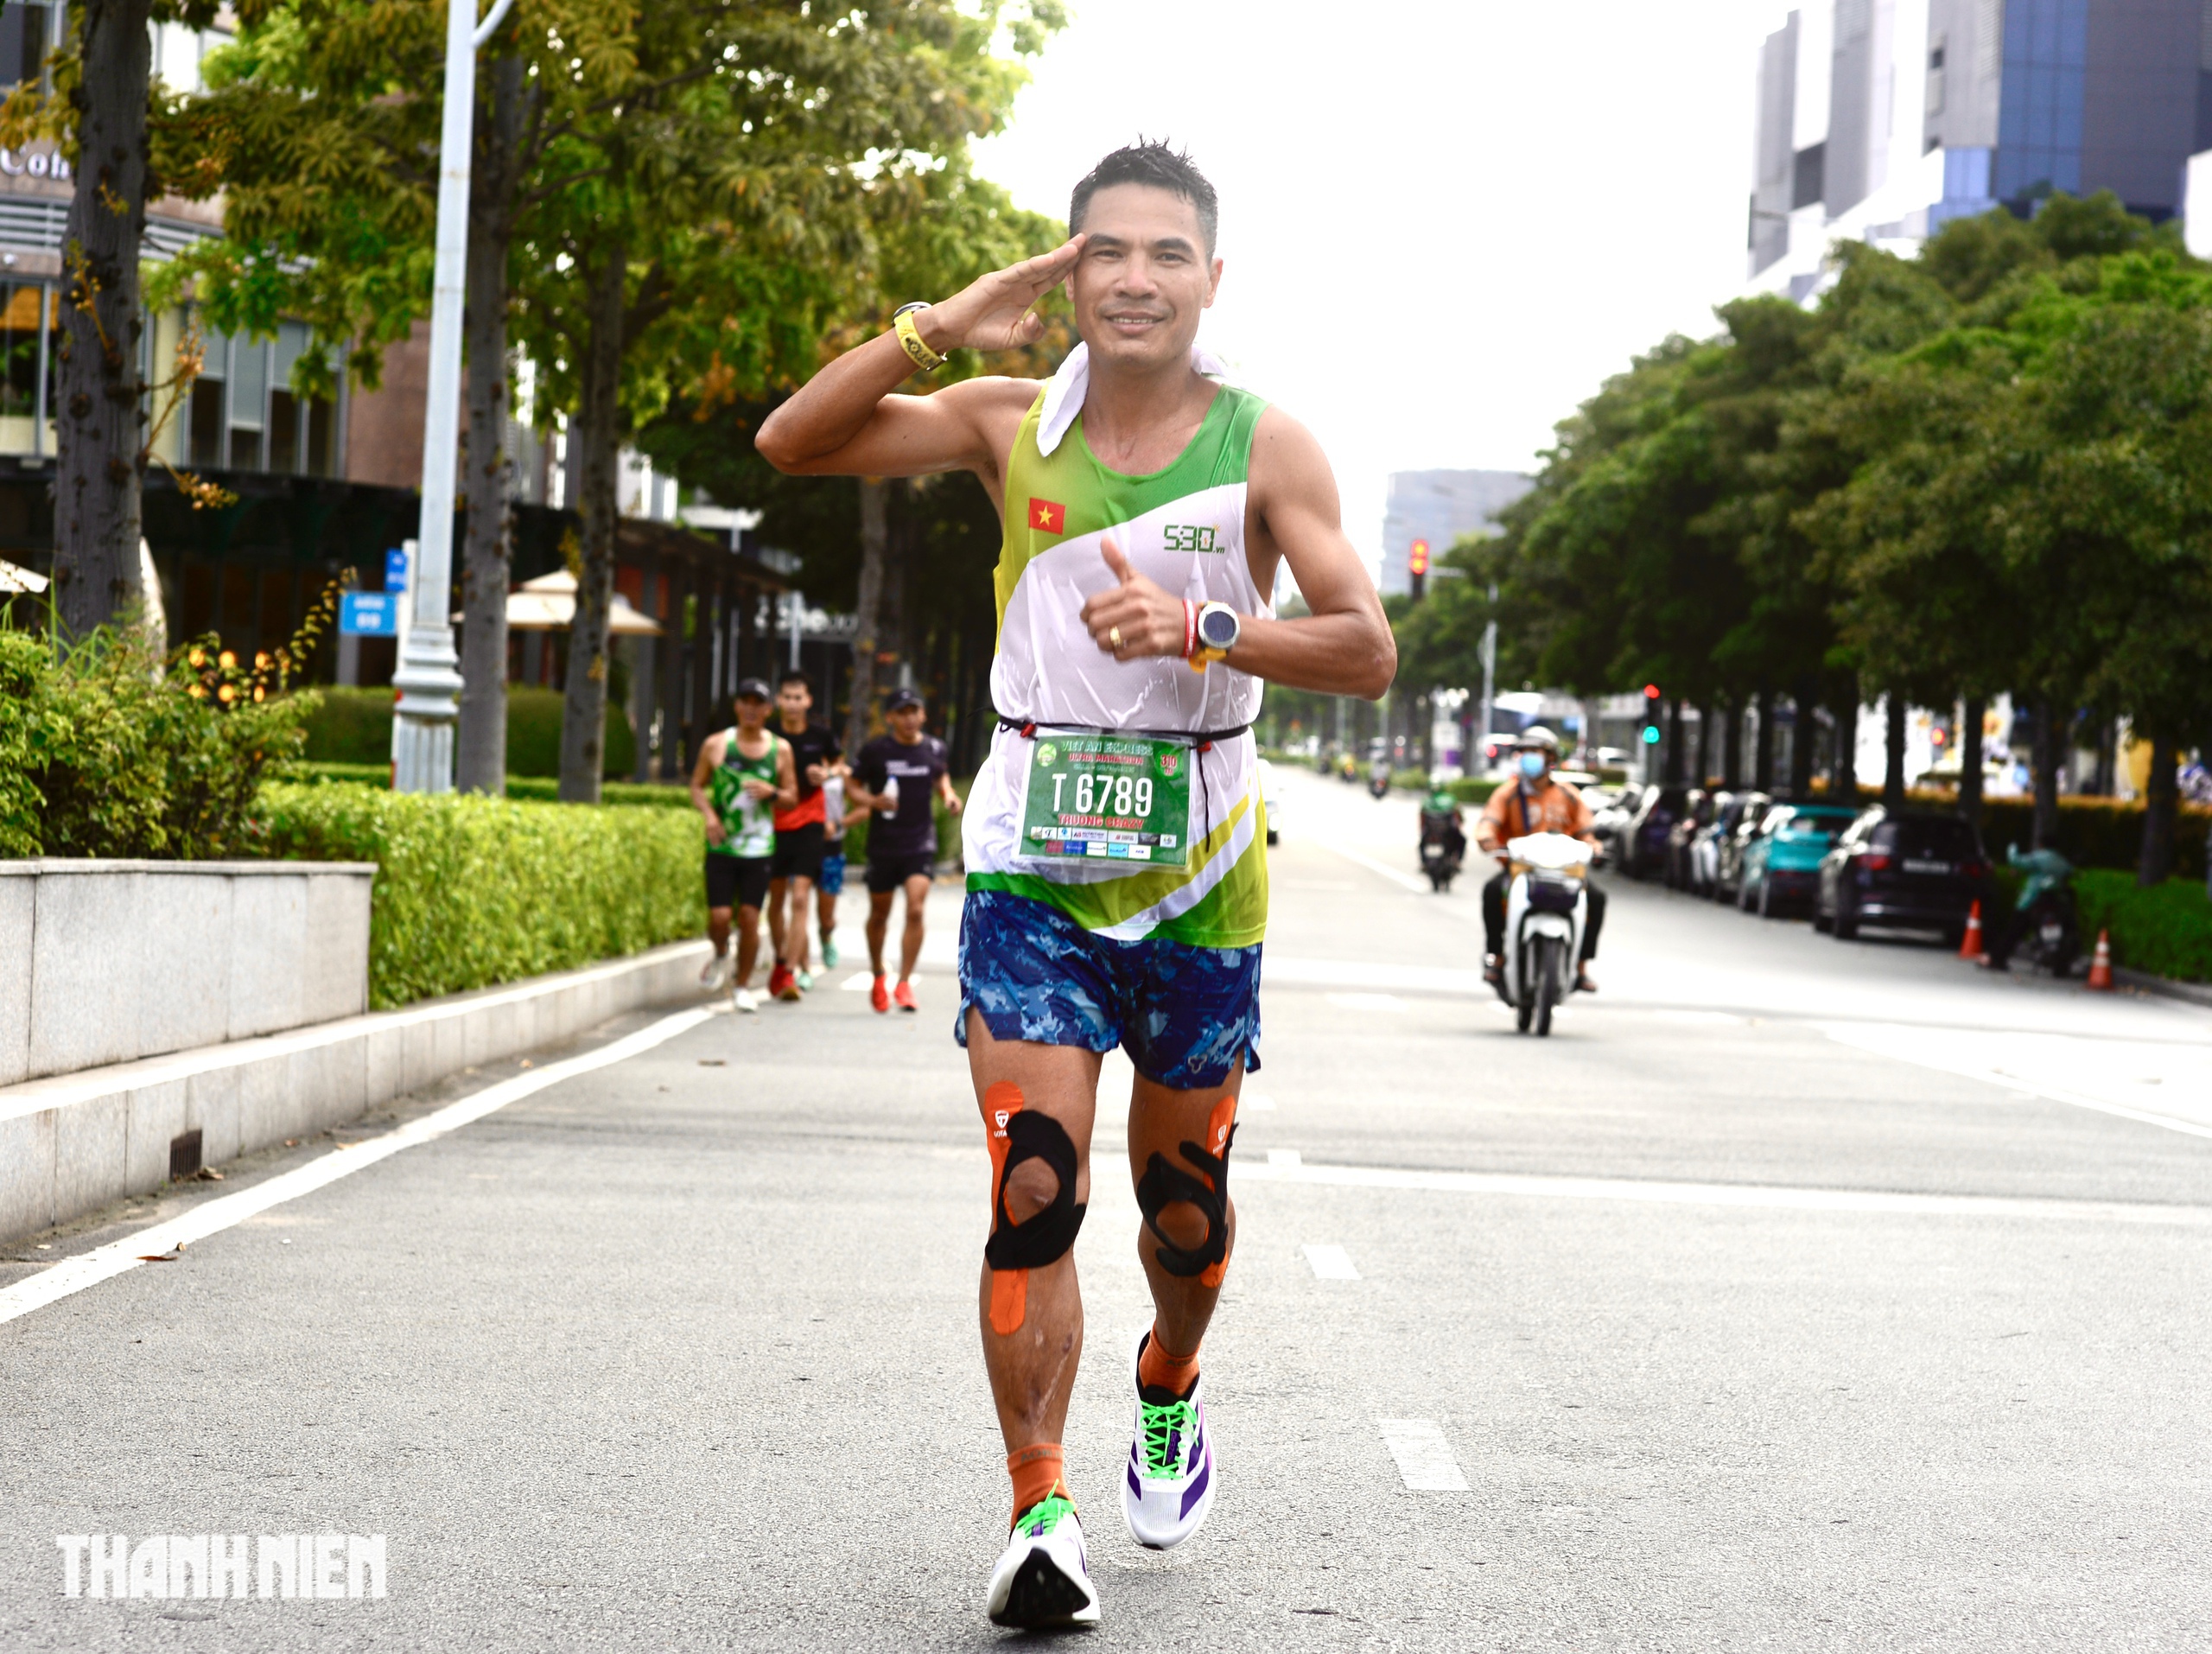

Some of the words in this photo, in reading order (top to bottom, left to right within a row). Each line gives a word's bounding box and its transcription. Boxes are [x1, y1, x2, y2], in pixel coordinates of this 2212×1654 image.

[1095, 754, 1143, 766] MARATHON
[1052, 773, 1067, 812] T
[1075, 773, 1154, 817] 6789
[1105, 815, 1145, 829] CRAZY
